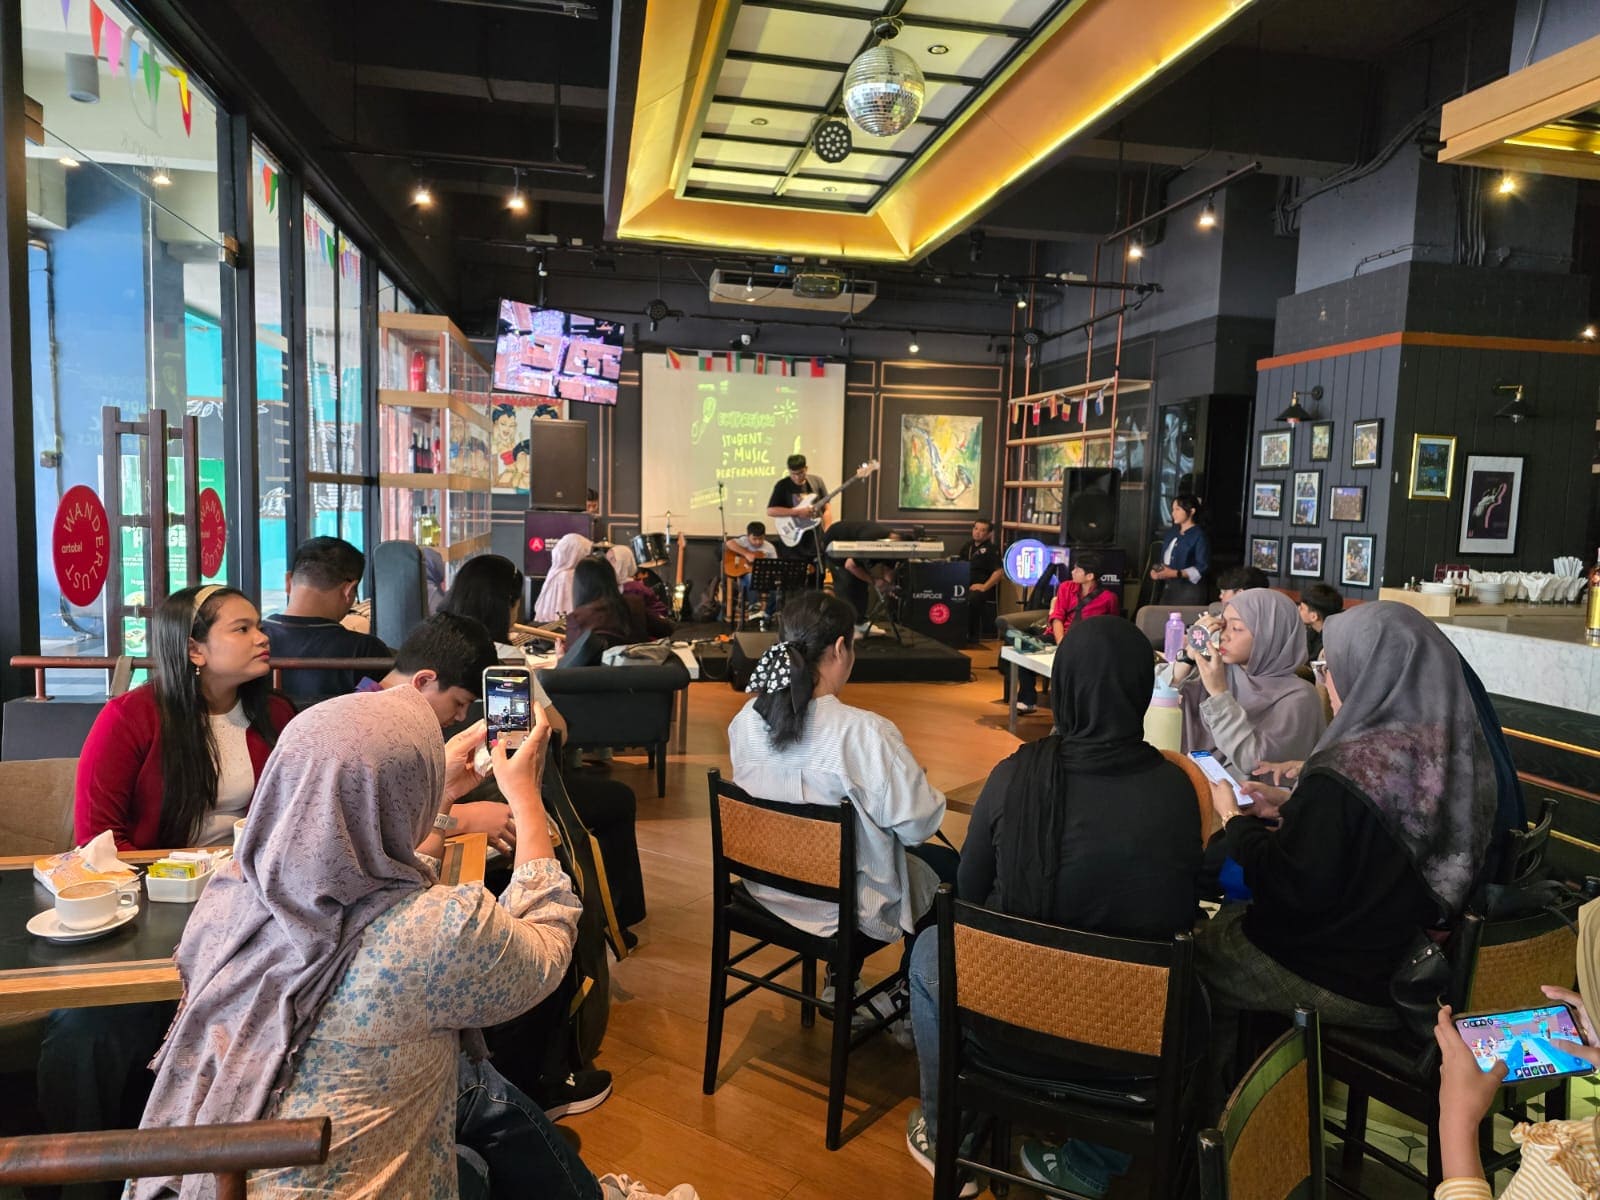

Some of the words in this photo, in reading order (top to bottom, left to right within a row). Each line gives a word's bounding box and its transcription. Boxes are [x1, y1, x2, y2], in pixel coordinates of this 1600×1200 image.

[722, 432, 762, 448] STUDENT
[734, 446, 769, 464] MUSIC
[715, 466, 776, 480] PERFORMANCE
[63, 502, 104, 591] WANDERLUST
